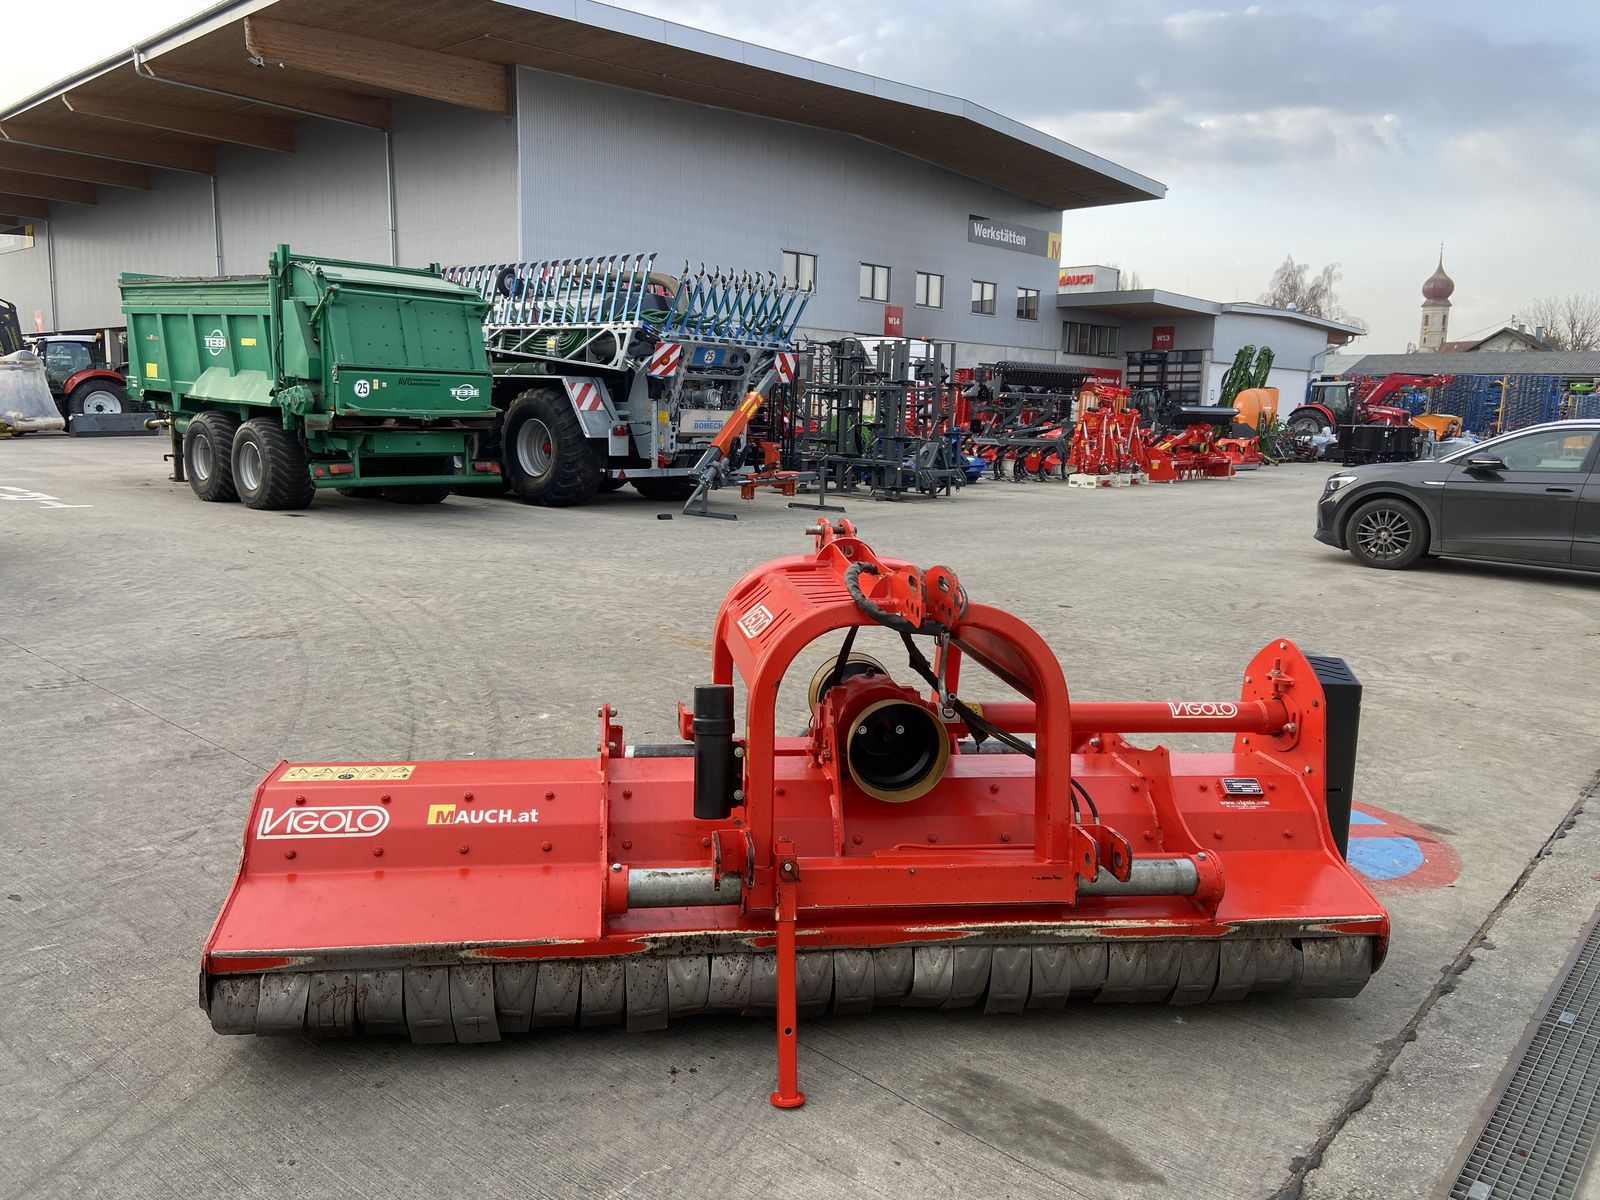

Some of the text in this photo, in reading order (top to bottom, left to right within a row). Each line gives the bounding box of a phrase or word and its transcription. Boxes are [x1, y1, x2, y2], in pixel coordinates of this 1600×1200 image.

[974, 222, 1026, 246] Werkstätten
[1059, 274, 1094, 286] MAUCH
[888, 316, 900, 325] W14
[1156, 334, 1170, 342] W13
[705, 351, 715, 361] 25
[357, 382, 368, 395] 25
[1167, 702, 1238, 718] VIGOLO
[257, 806, 389, 839] VIGOLO
[433, 808, 539, 824] MAUCH.at
